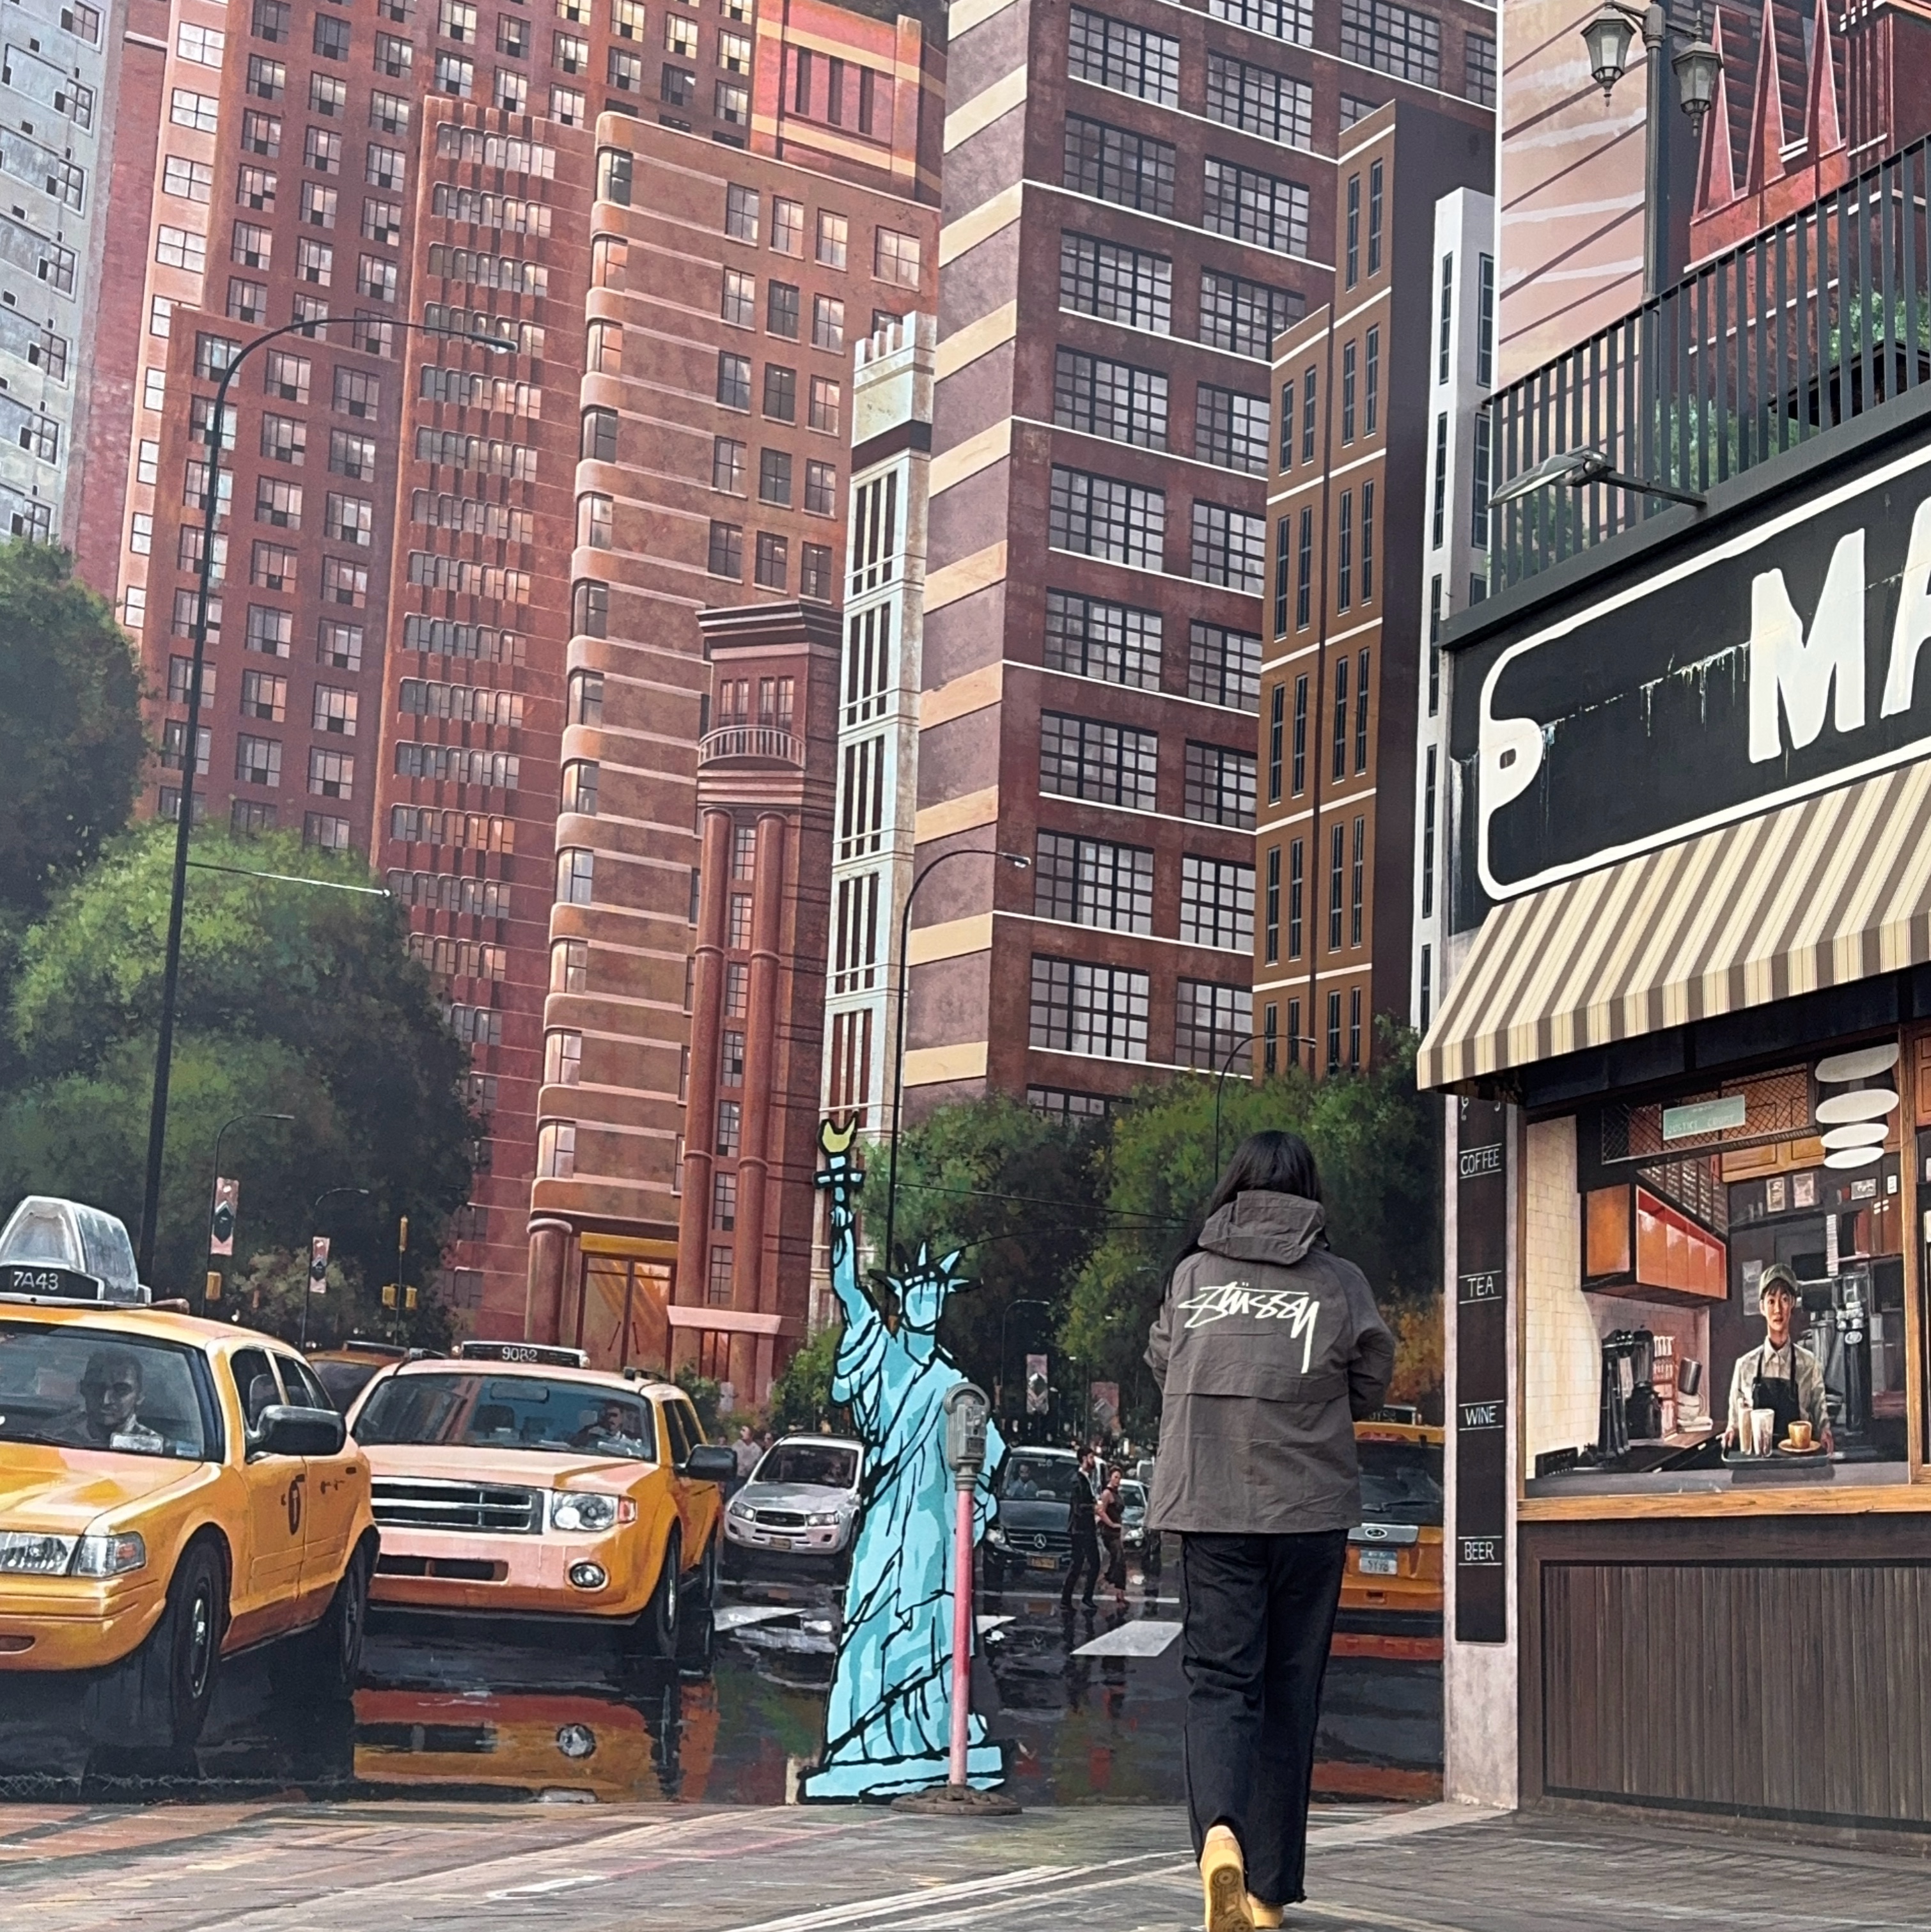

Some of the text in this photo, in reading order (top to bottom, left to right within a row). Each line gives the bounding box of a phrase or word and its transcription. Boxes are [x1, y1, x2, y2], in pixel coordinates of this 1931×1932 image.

[1460, 1148, 1500, 1176] COFFEE
[13, 1271, 59, 1291] 7A43
[1467, 1275, 1494, 1298] TEA
[502, 1346, 538, 1362] 9082
[1465, 1406, 1497, 1426] WINE
[1464, 1541, 1495, 1561] BEER
